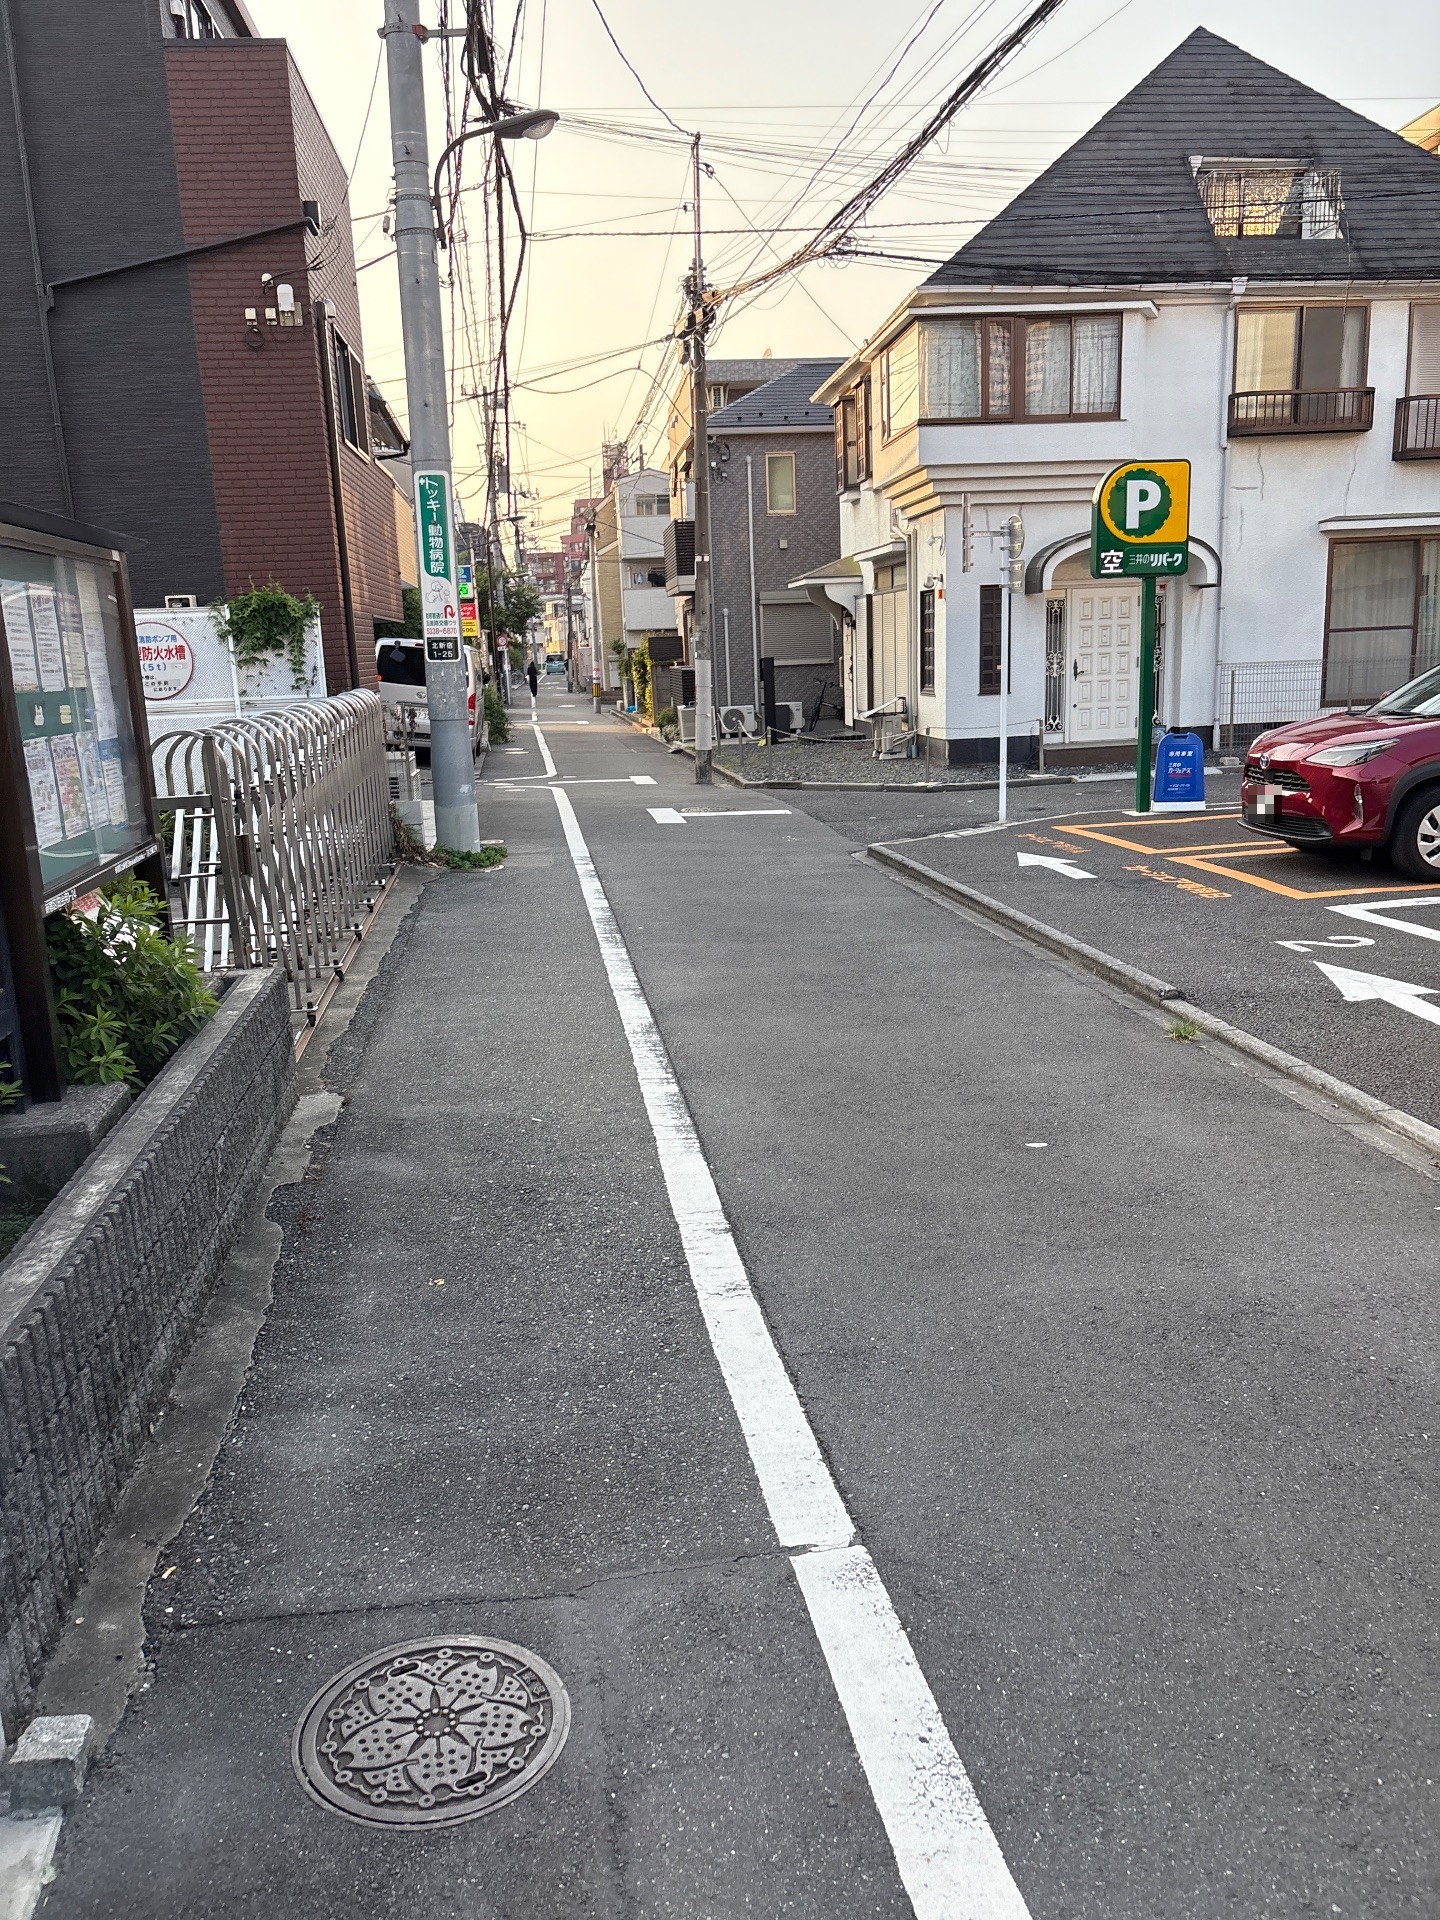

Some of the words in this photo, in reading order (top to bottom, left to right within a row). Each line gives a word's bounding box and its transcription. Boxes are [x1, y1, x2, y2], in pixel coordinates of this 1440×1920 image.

[1125, 479, 1162, 530] P
[423, 476, 445, 574] トッキー動物病院
[1100, 549, 1124, 574] 空
[1128, 552, 1183, 567] 三井のリパーク
[137, 635, 177, 643] 消防ポンプ用
[1274, 935, 1376, 953] 2
